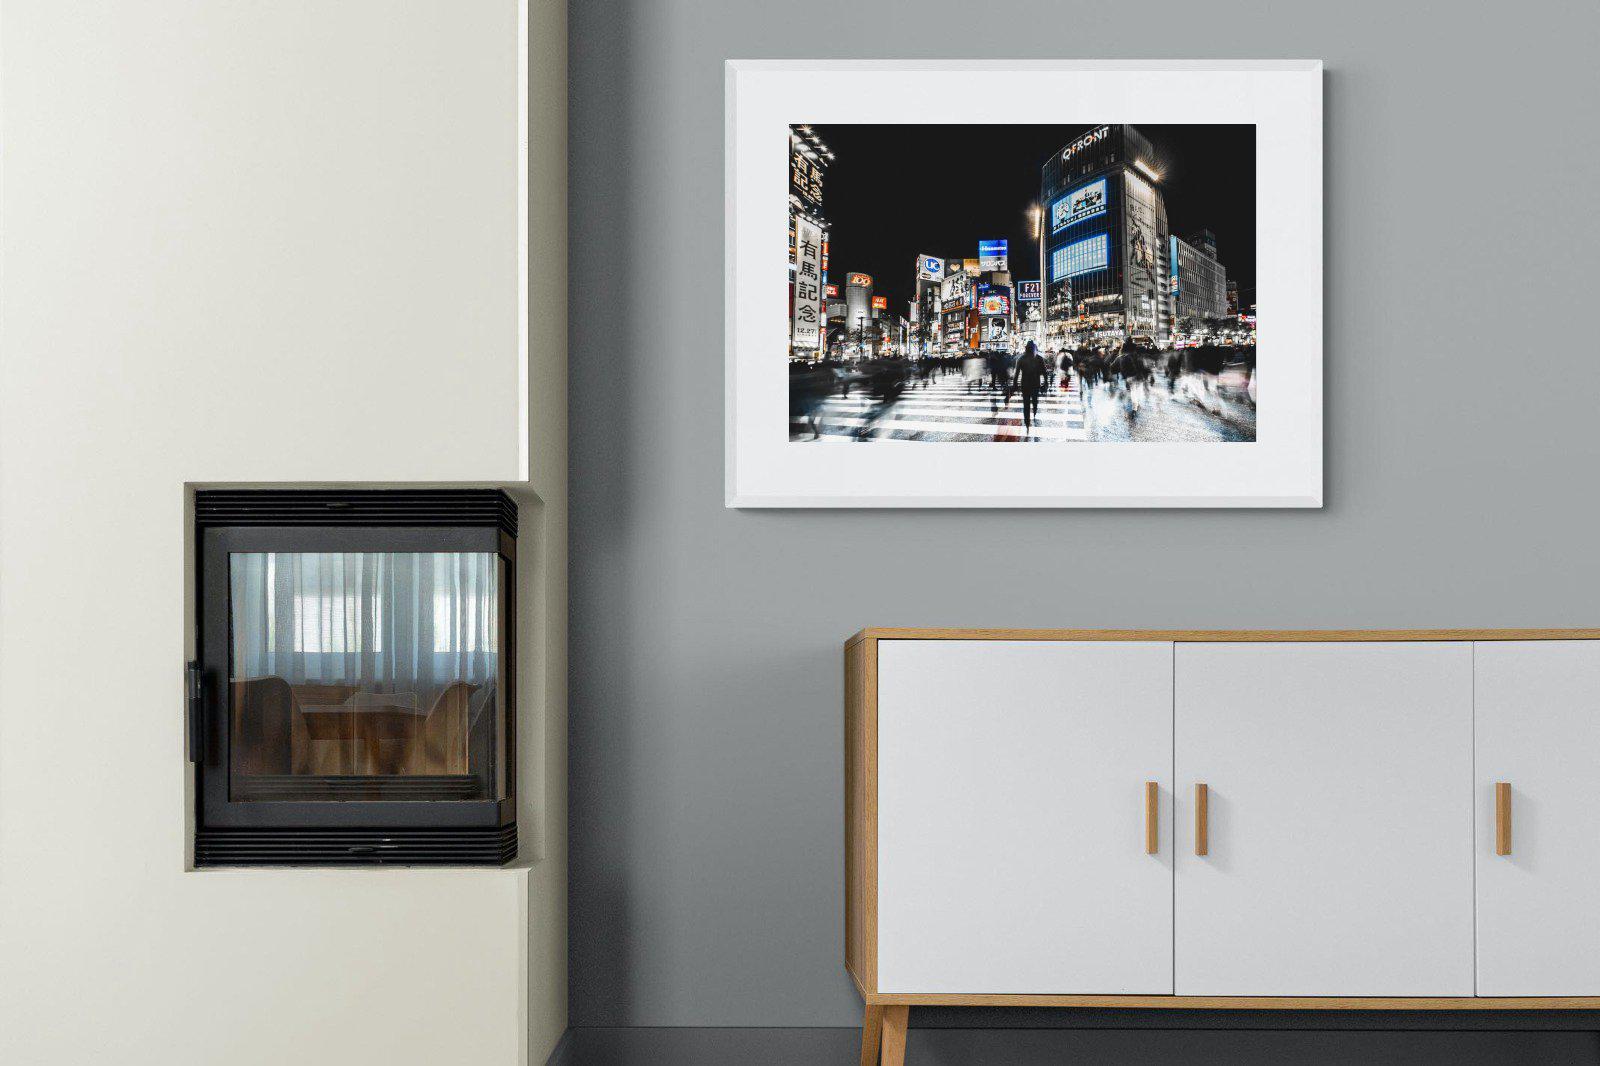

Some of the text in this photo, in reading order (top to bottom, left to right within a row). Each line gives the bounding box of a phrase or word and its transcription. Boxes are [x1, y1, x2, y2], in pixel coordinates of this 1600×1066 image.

[1062, 126, 1109, 160] QFRONT
[798, 240, 818, 323] 有馬記念
[852, 275, 871, 287] 109
[1094, 329, 1124, 337] TSUTAYA
